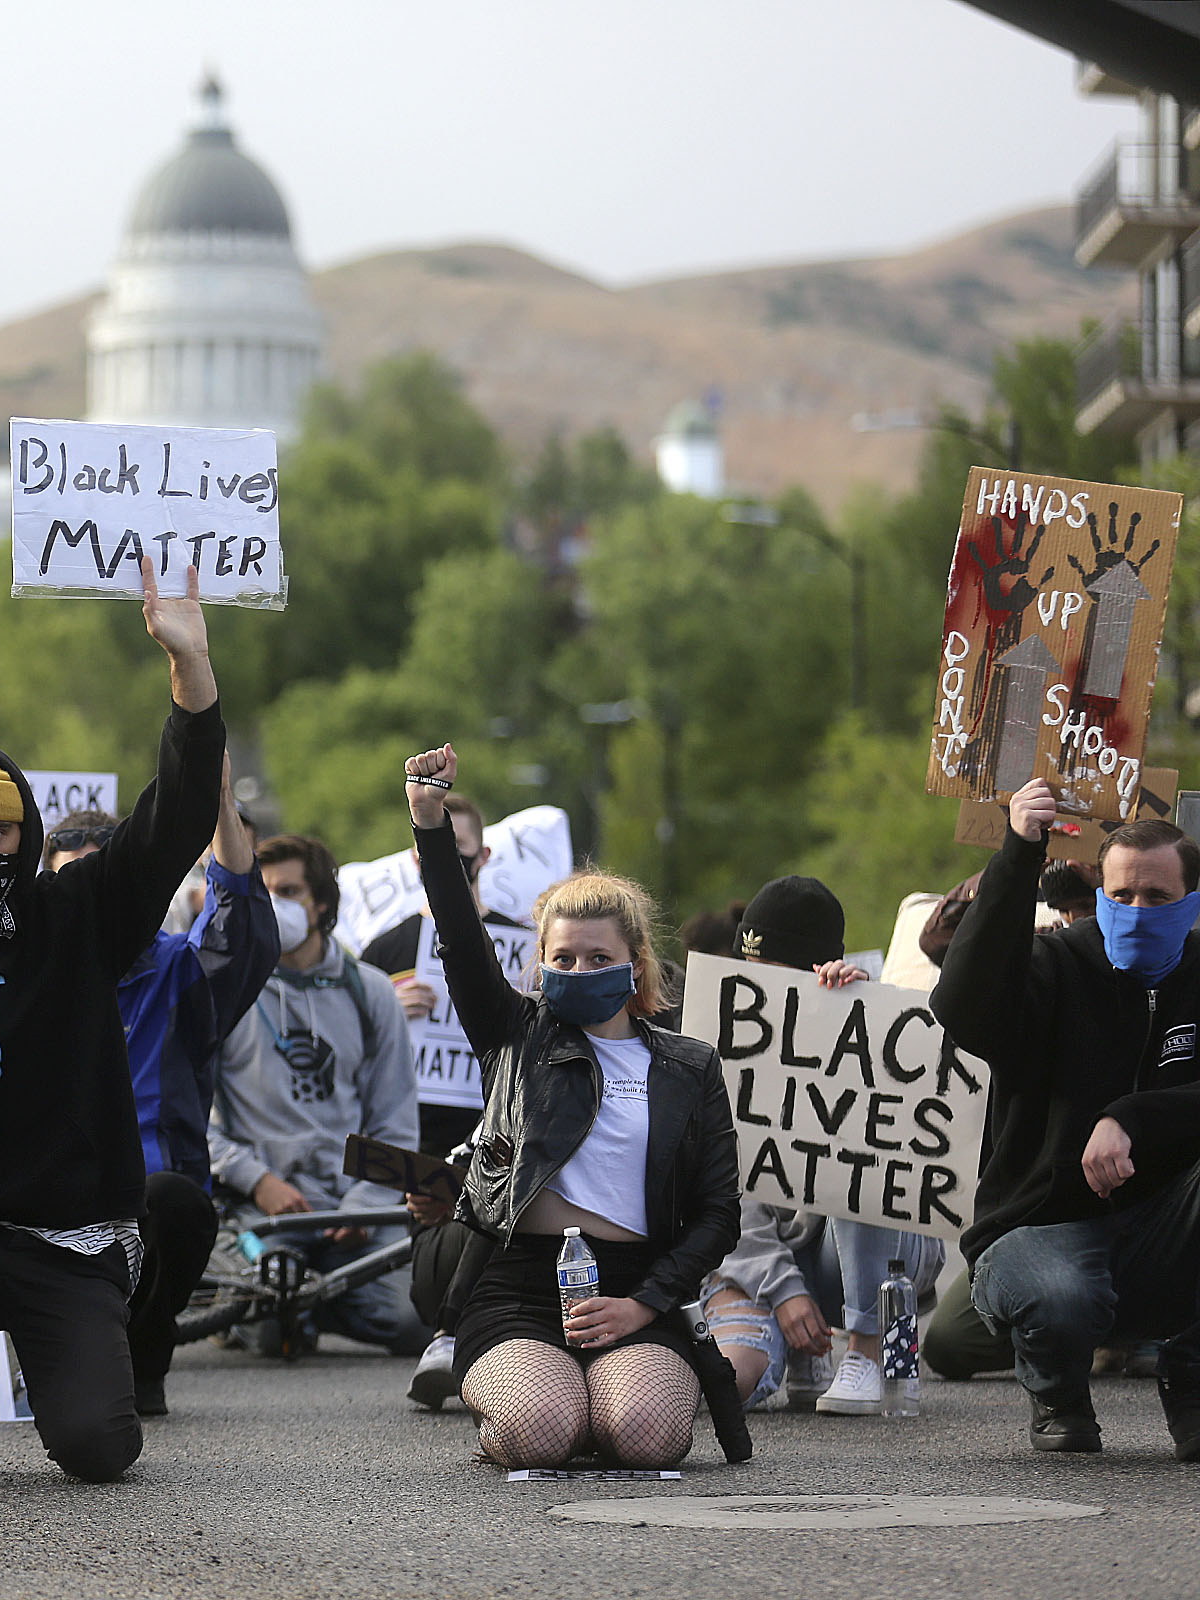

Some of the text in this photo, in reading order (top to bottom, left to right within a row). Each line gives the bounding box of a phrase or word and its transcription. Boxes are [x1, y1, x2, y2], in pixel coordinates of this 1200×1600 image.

[19, 437, 277, 513] Black Lives
[976, 478, 1090, 528] HANDS
[38, 519, 267, 579] MATTER
[1038, 590, 1083, 630] UP
[1042, 683, 1140, 819] SHOOT!
[30, 783, 104, 813] ACK
[717, 973, 983, 1096] BLACK
[736, 1067, 954, 1158] LIVES
[745, 1136, 965, 1229] ATTER
